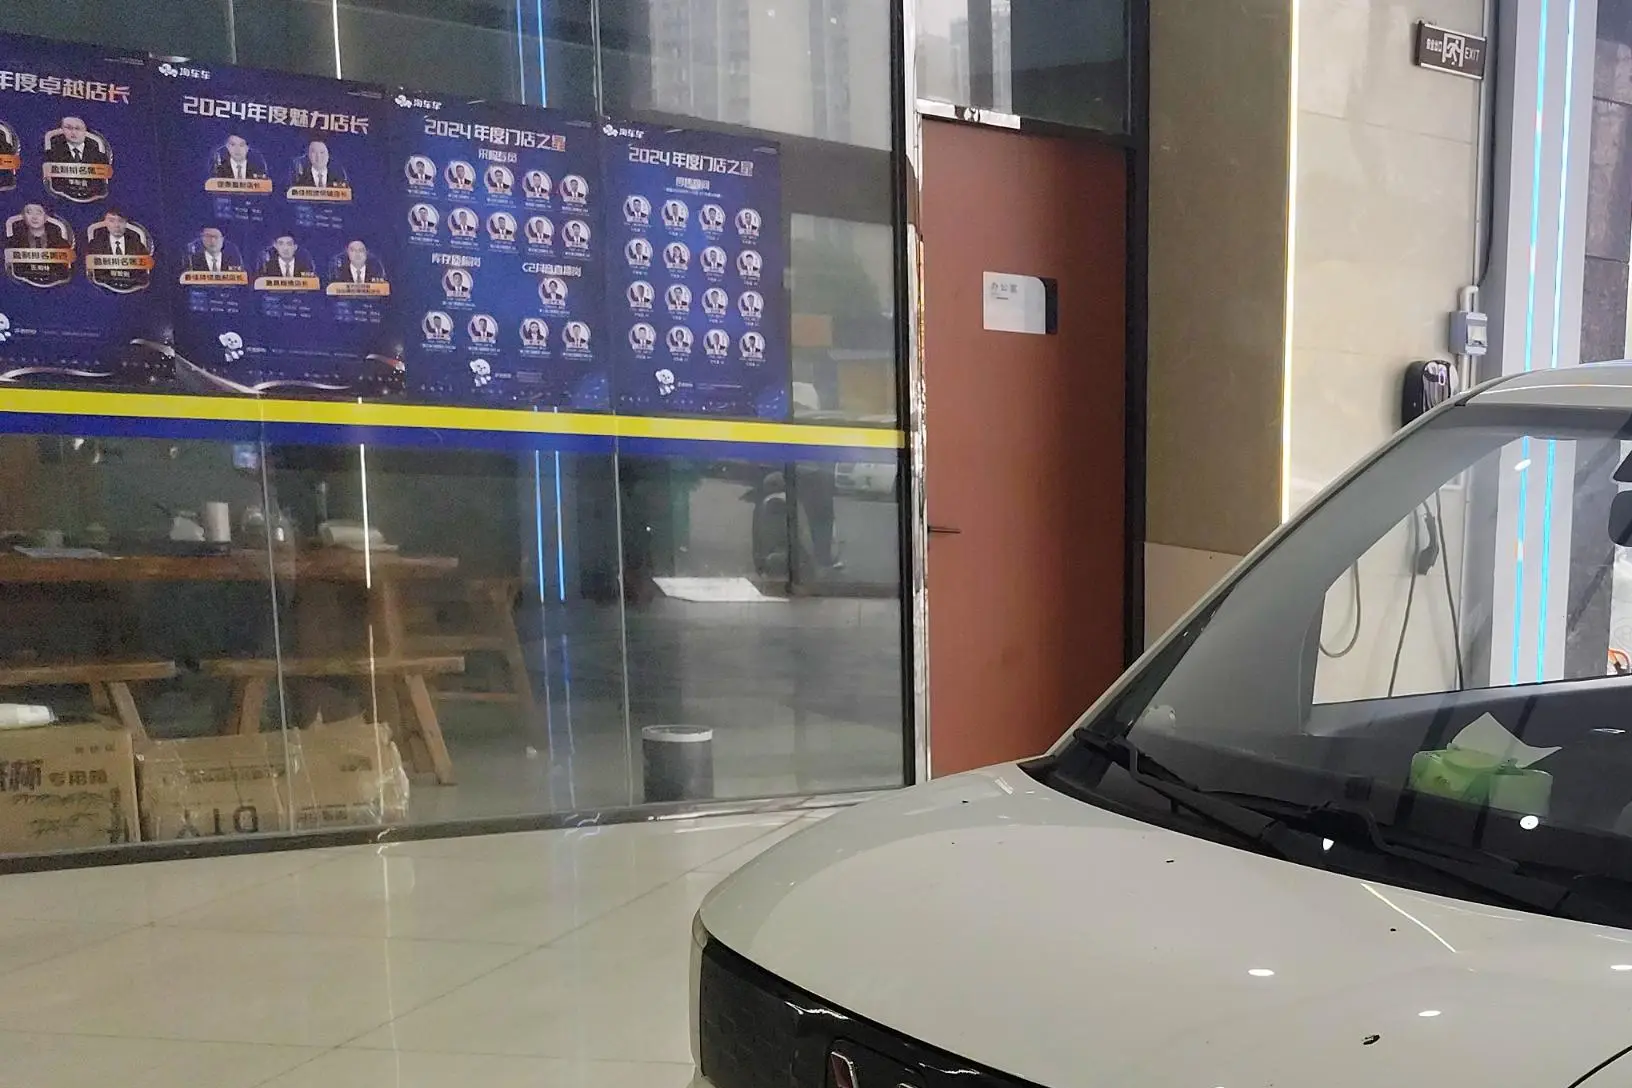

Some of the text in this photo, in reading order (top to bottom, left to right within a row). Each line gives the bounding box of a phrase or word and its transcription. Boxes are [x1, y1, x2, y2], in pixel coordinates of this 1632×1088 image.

[1464, 46, 1480, 61] EXIT
[182, 95, 369, 135] 2024年度魅力店长
